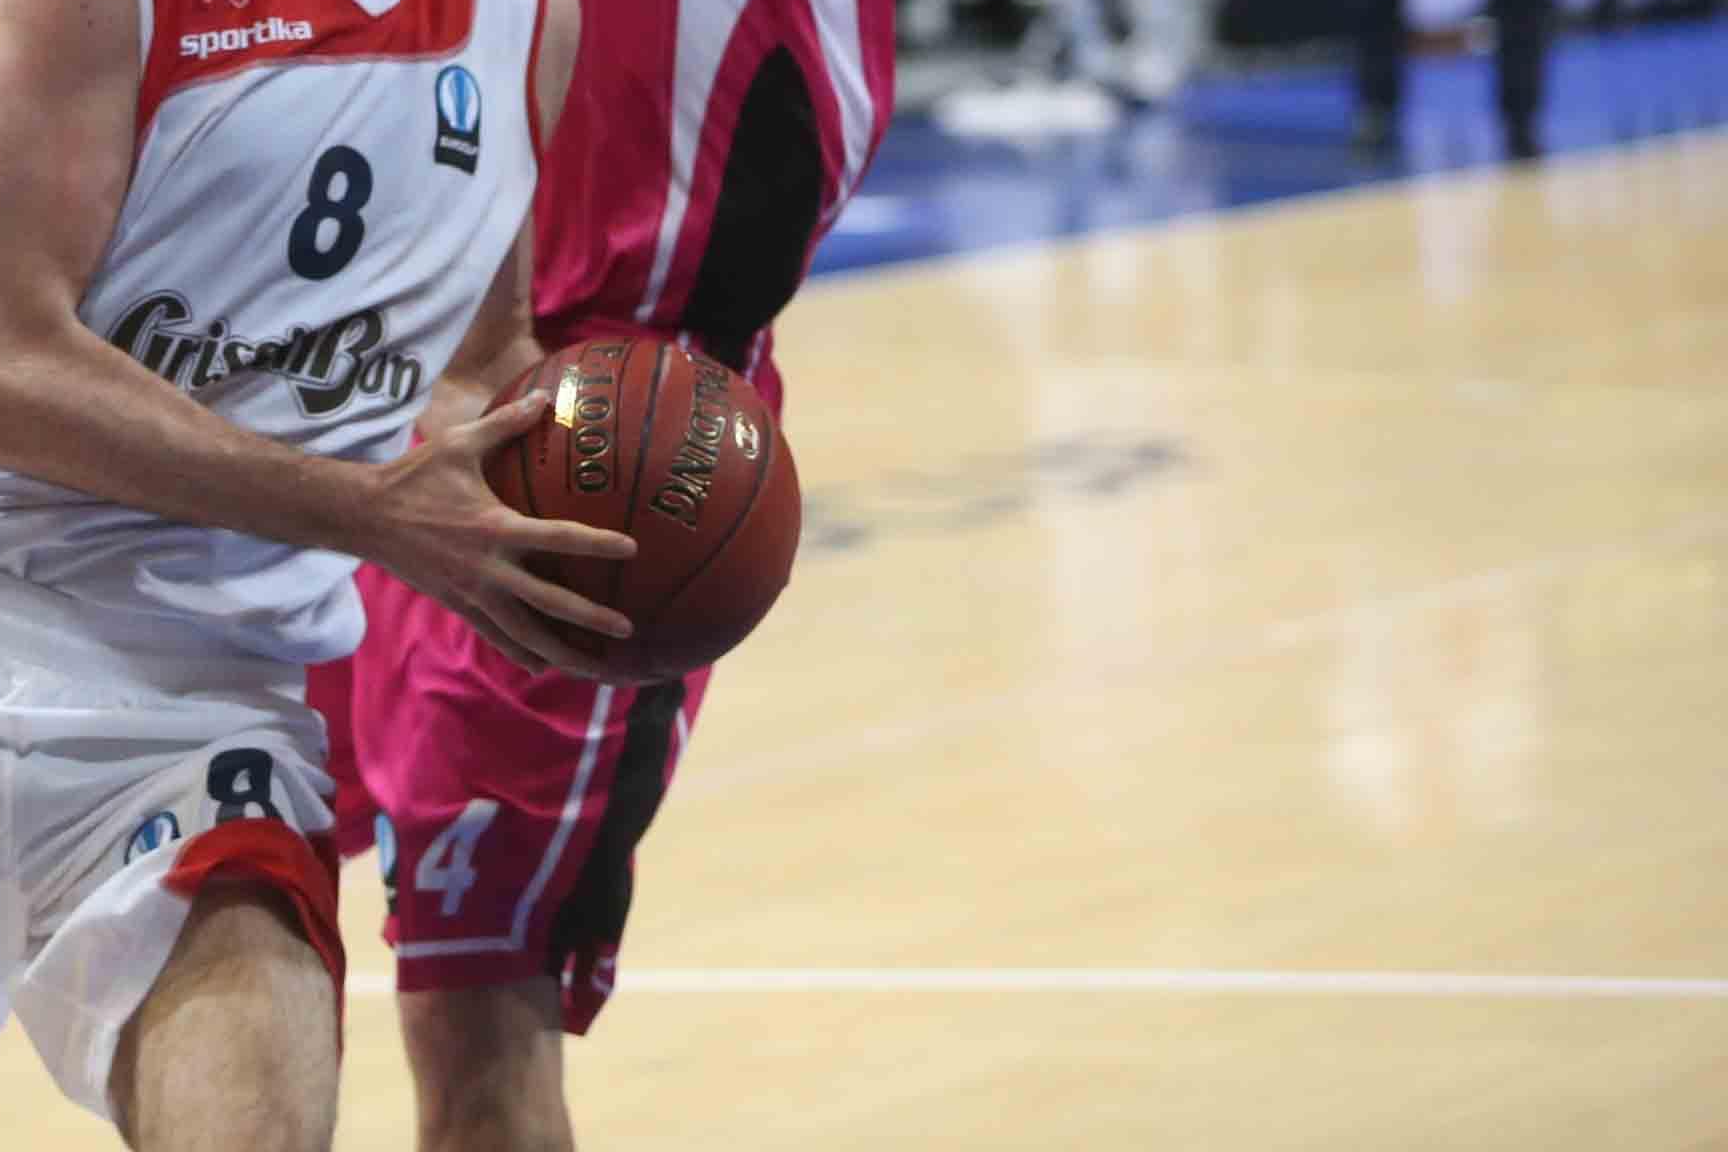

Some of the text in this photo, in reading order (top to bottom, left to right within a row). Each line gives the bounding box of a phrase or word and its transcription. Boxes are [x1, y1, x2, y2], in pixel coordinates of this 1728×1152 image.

[180, 16, 314, 59] sportika
[287, 145, 372, 280] 8
[415, 798, 500, 917] 4
